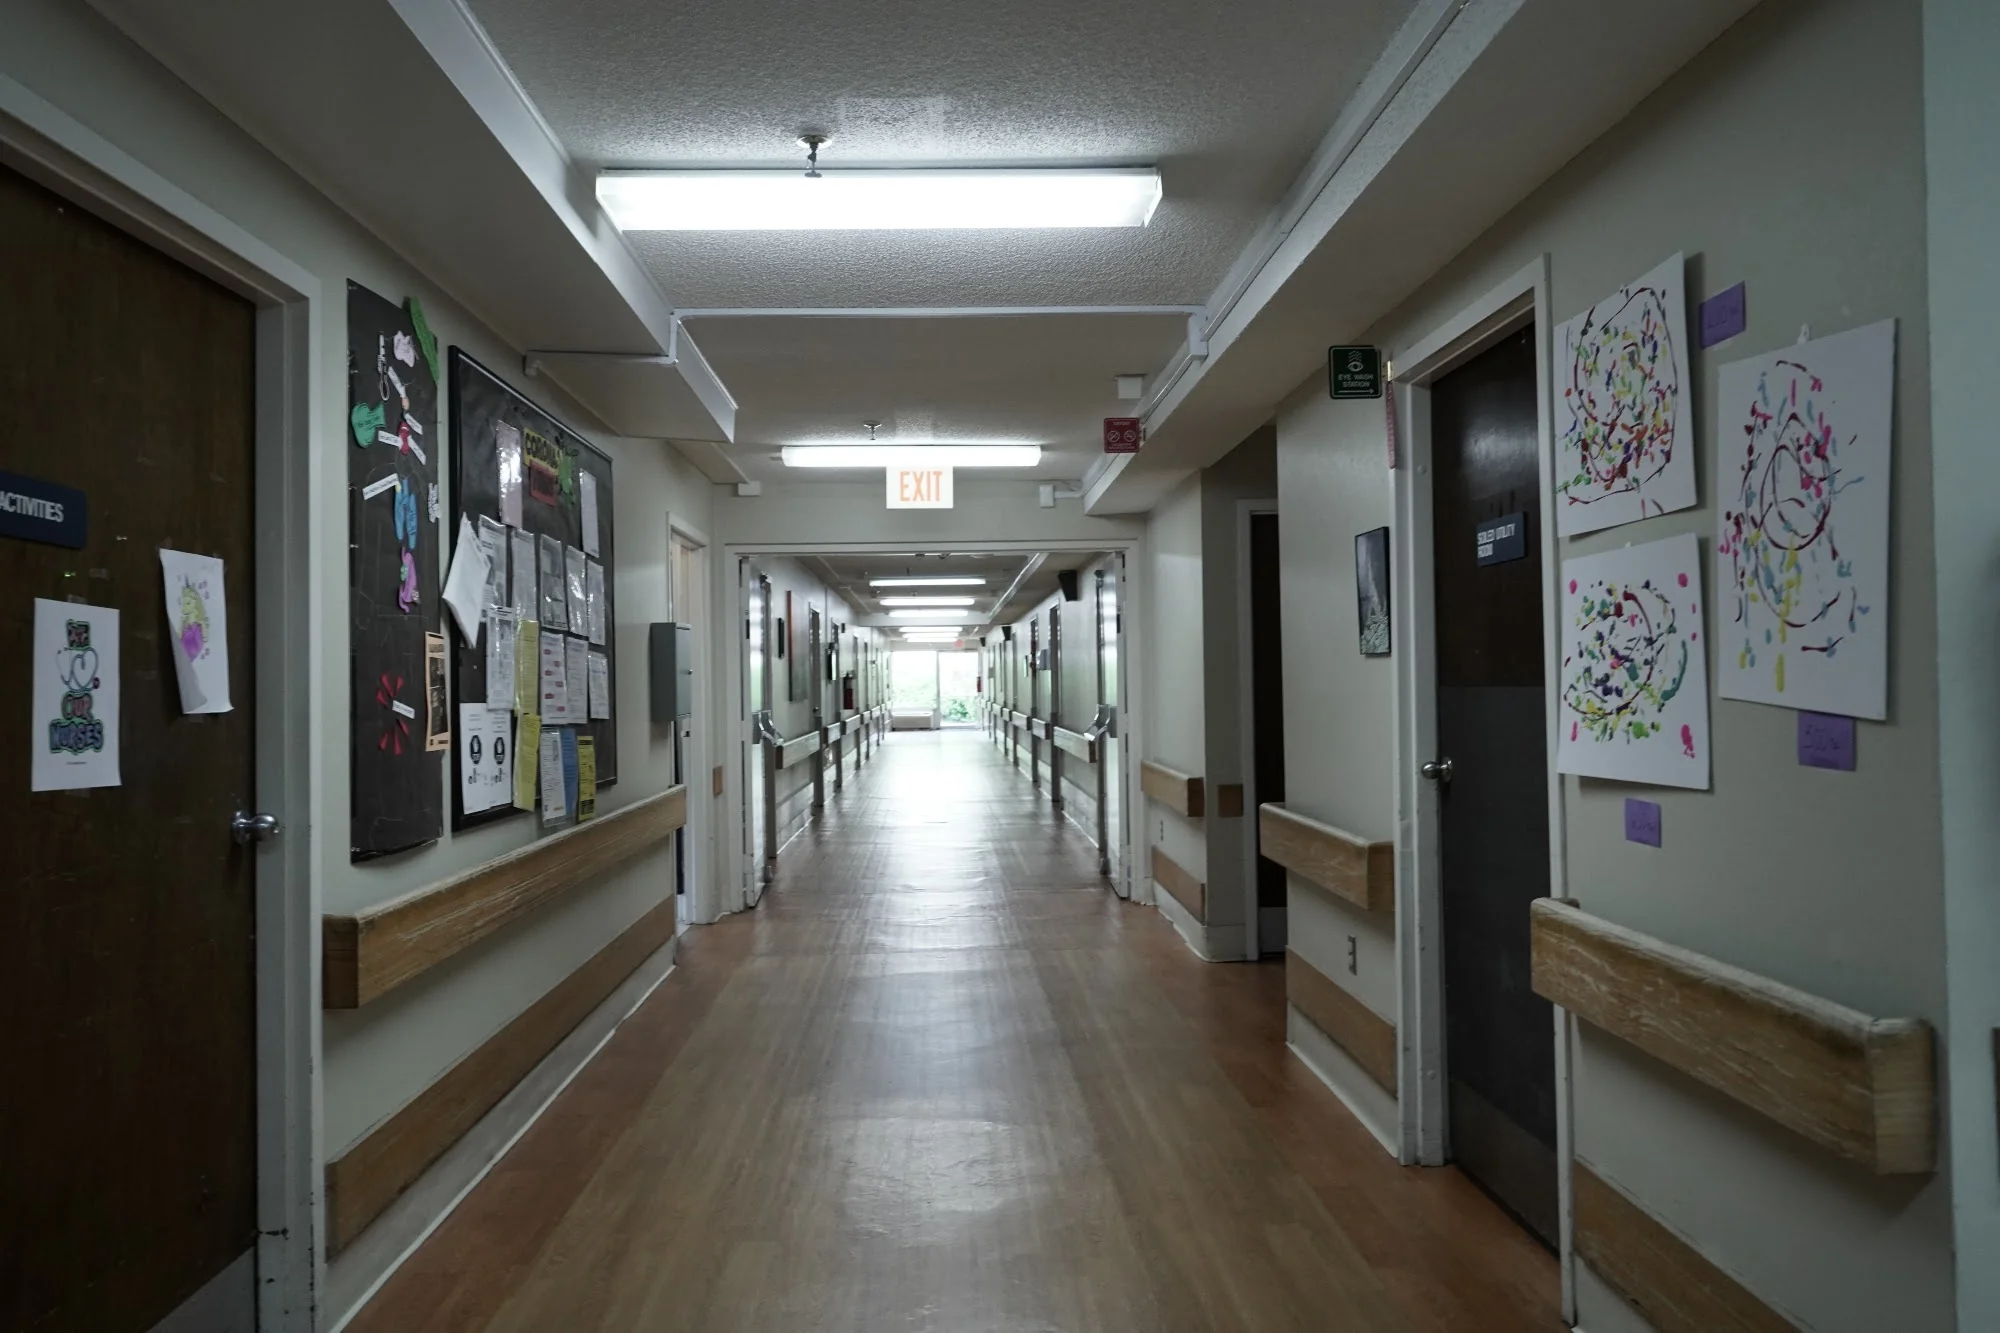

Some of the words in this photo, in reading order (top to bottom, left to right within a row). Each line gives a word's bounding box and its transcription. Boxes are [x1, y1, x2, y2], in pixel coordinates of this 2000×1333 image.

[900, 471, 943, 501] EXIT
[1477, 529, 1495, 545] SOILED
[1496, 523, 1516, 540] UTILITY
[1477, 544, 1493, 558] ROOM
[50, 719, 103, 754] NURSES
